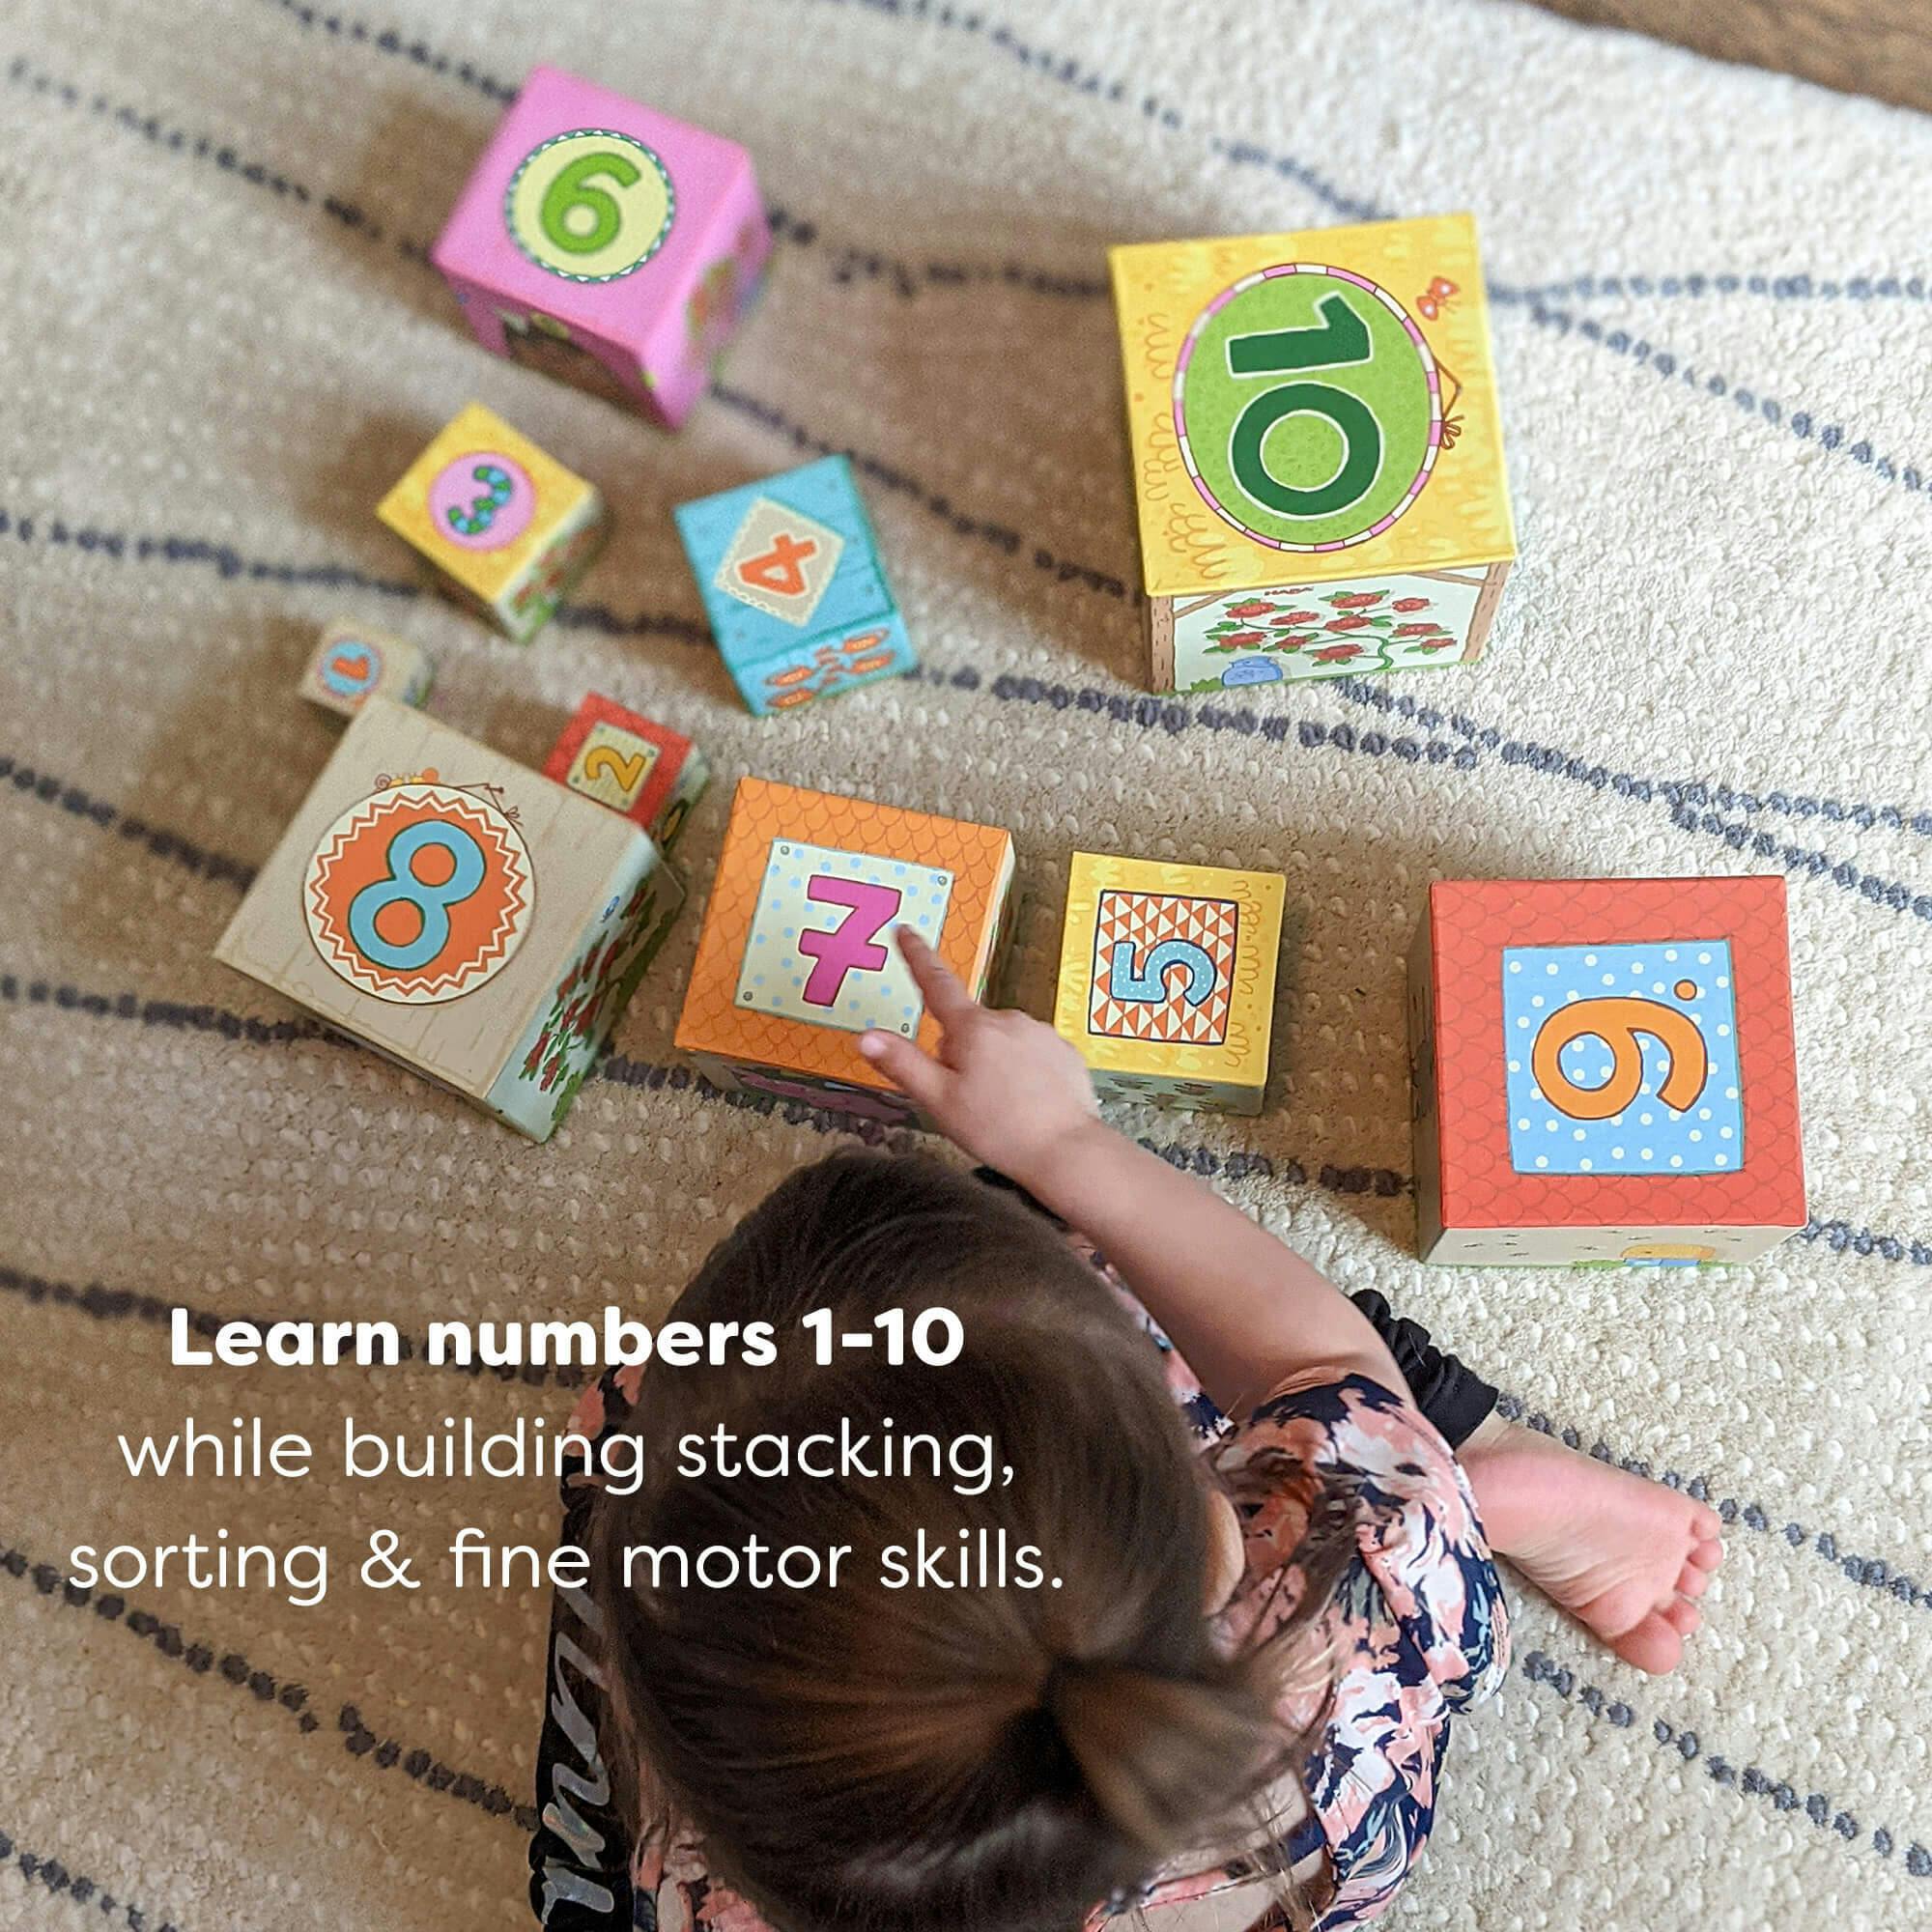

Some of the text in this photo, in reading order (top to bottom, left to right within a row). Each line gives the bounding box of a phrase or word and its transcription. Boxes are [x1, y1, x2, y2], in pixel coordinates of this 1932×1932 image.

[538, 151, 642, 256] 6
[1226, 291, 1385, 522] 10
[446, 465, 514, 536] 3
[737, 532, 818, 597] 4
[583, 744, 647, 793] 2
[348, 818, 487, 971] 8
[797, 873, 903, 1008] 7
[1111, 938, 1218, 1008] 5
